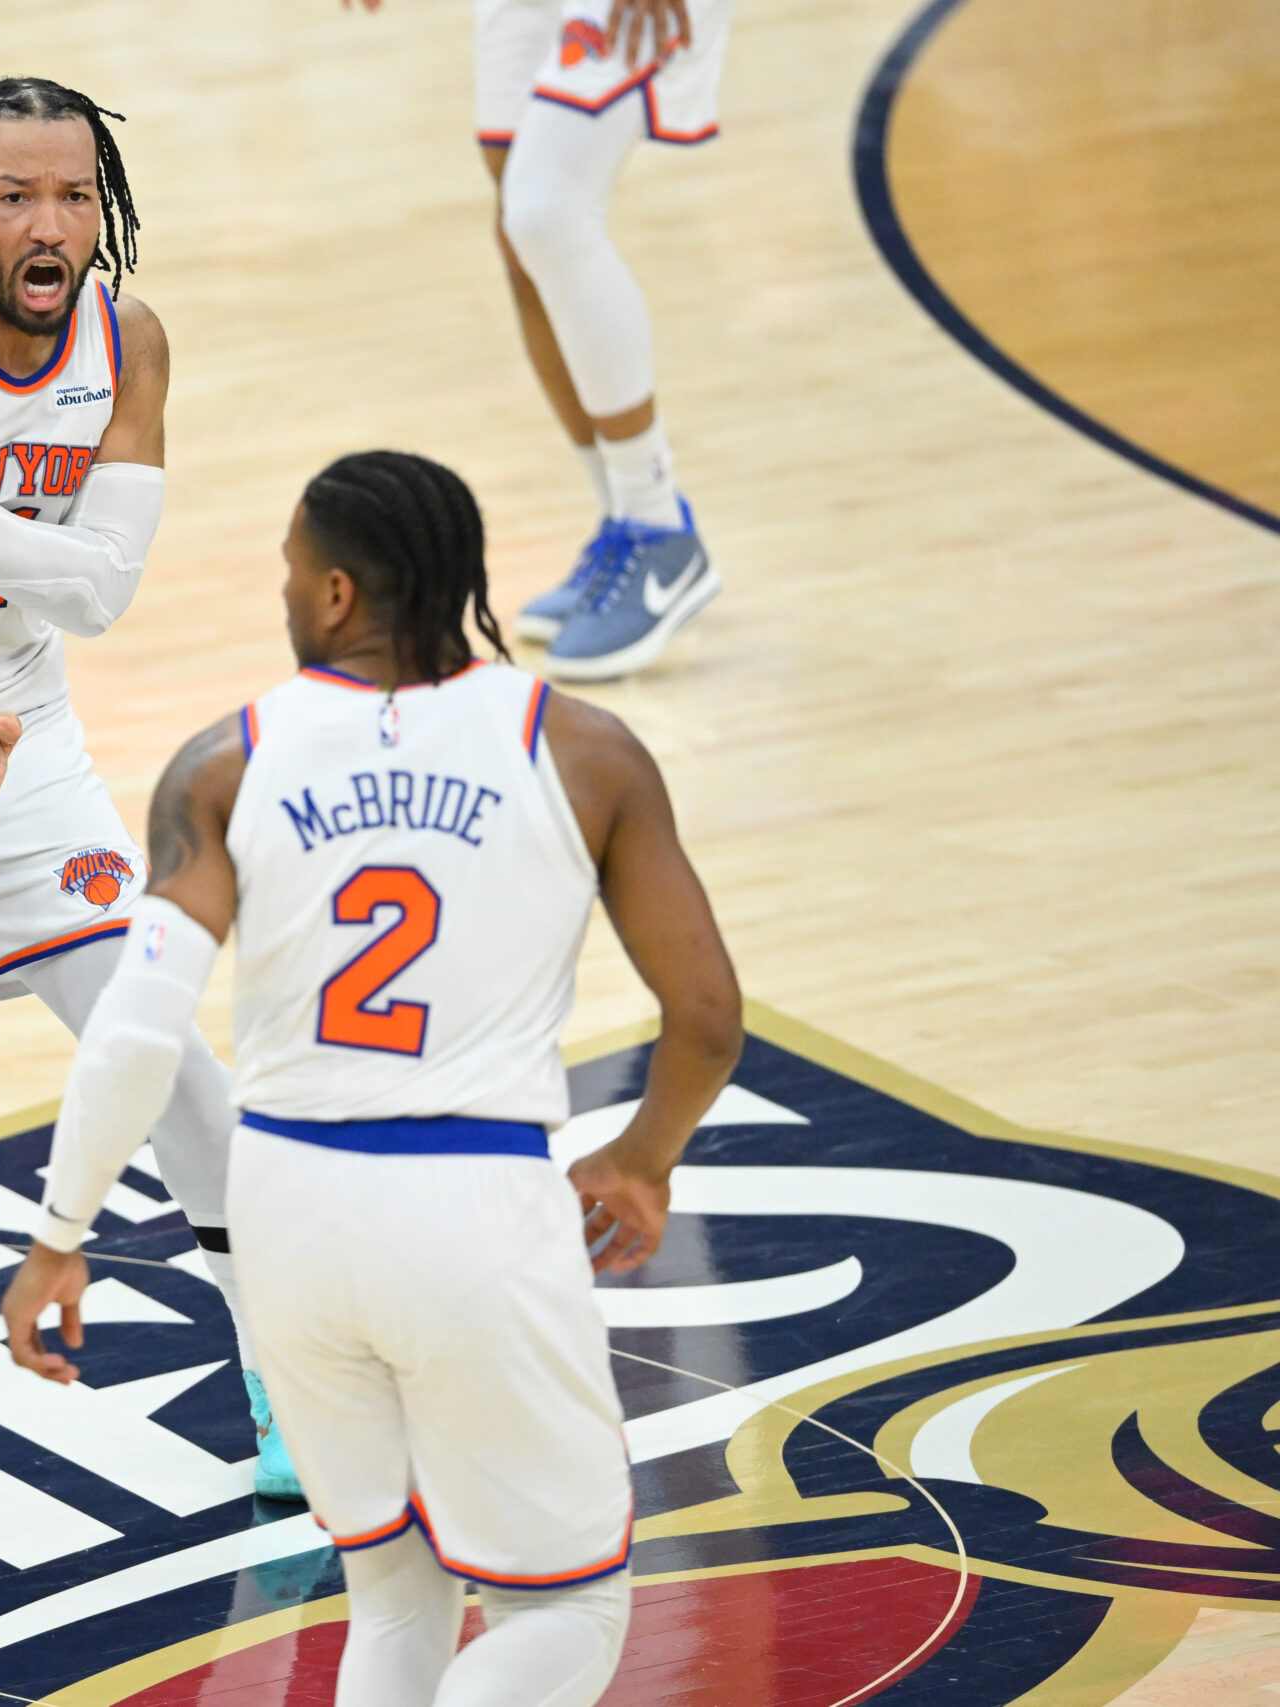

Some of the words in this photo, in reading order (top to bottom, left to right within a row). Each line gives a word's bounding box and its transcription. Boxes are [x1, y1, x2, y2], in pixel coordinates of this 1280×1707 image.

[56, 386, 89, 395] experience
[56, 395, 81, 406] abu
[83, 386, 112, 403] dhabi
[11, 443, 99, 497] YOR
[280, 770, 502, 853] McBRIDE
[60, 850, 135, 895] KNICKS
[316, 865, 441, 1058] 2
